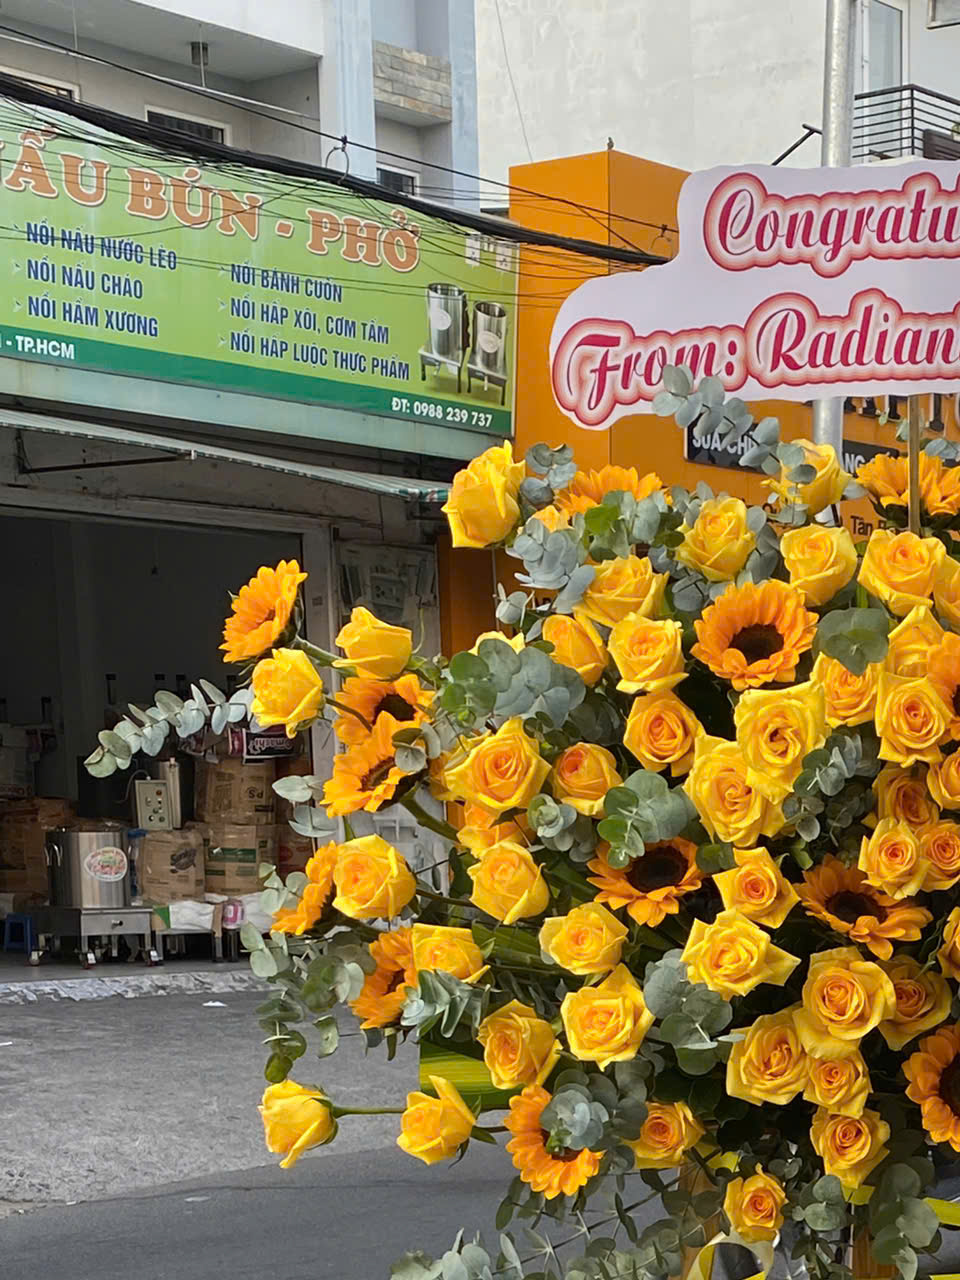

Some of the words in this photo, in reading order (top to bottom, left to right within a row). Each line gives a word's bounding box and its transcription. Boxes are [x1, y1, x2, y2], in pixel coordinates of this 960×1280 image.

[0, 124, 110, 207] ẤU
[126, 167, 263, 240] BÚN
[275, 218, 295, 239] -
[306, 208, 421, 273] PHỞ
[101, 274, 143, 299] CHÁO
[105, 309, 158, 337] XƯƠNG
[326, 316, 356, 339] CƠM
[15, 335, 75, 360] TP.HCM
[567, 333, 738, 411] From:
[391, 397, 411, 413] ĐT:
[413, 401, 443, 419] 0988
[446, 406, 468, 423] 239
[472, 411, 493, 427] 737
